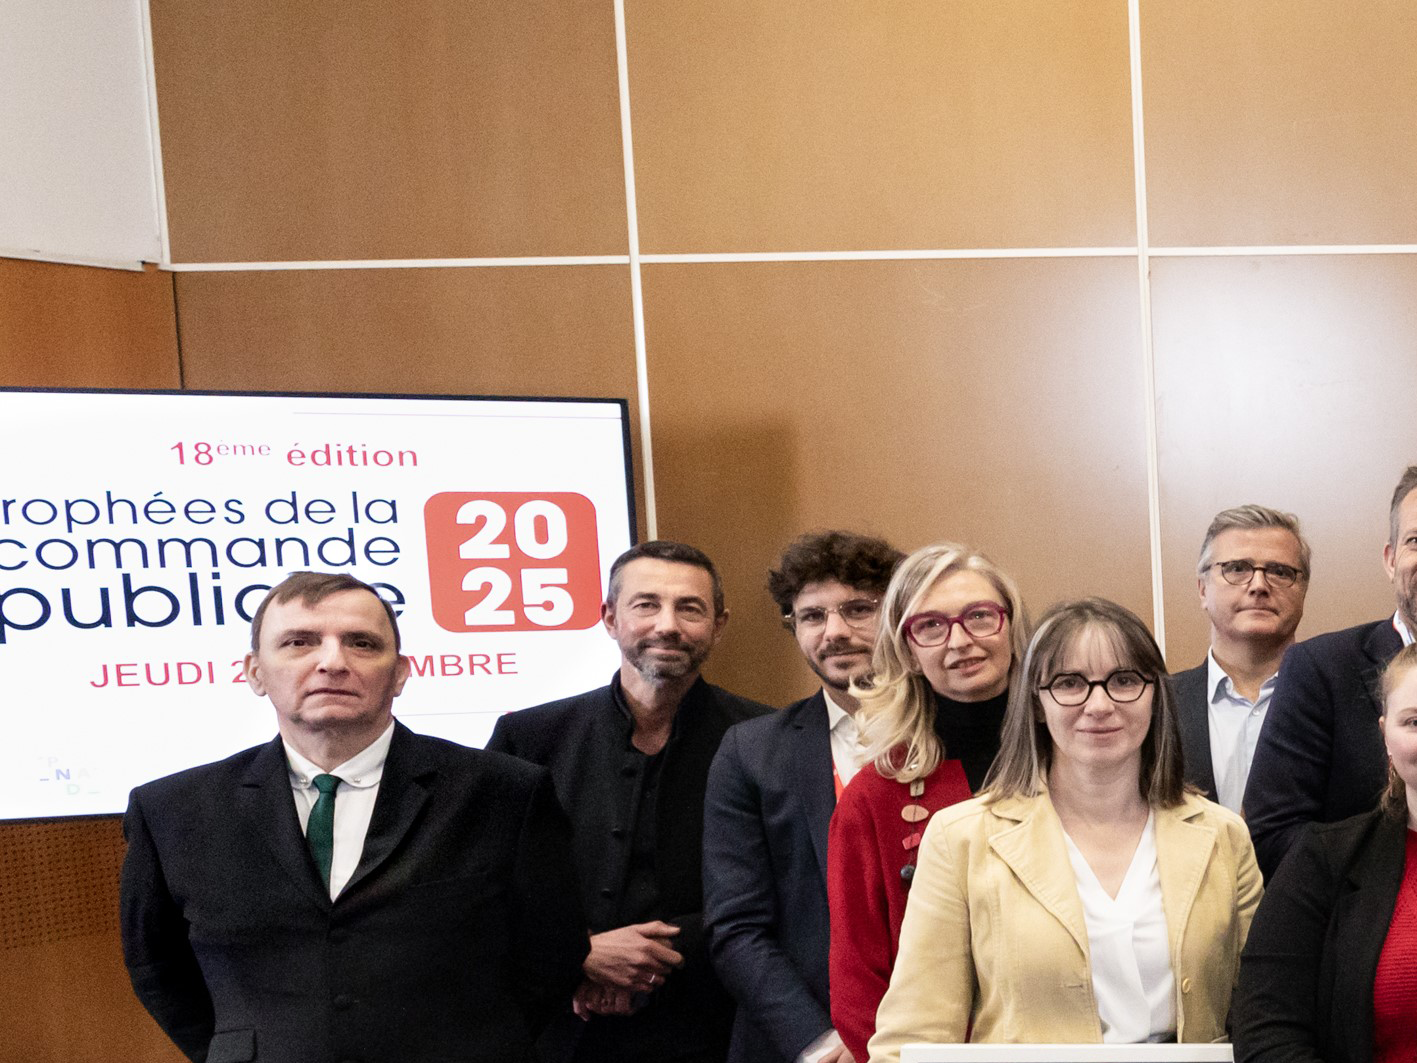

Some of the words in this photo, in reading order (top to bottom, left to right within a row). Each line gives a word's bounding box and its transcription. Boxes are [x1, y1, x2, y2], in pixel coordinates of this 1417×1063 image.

[170, 440, 271, 467] 18ème
[286, 442, 419, 468] édition
[2, 490, 245, 533] rophées
[265, 491, 336, 524] de
[352, 491, 398, 524] la
[455, 500, 568, 560] 20
[0, 528, 400, 570] commande
[461, 567, 574, 628] 25
[90, 660, 214, 690] JEUDI
